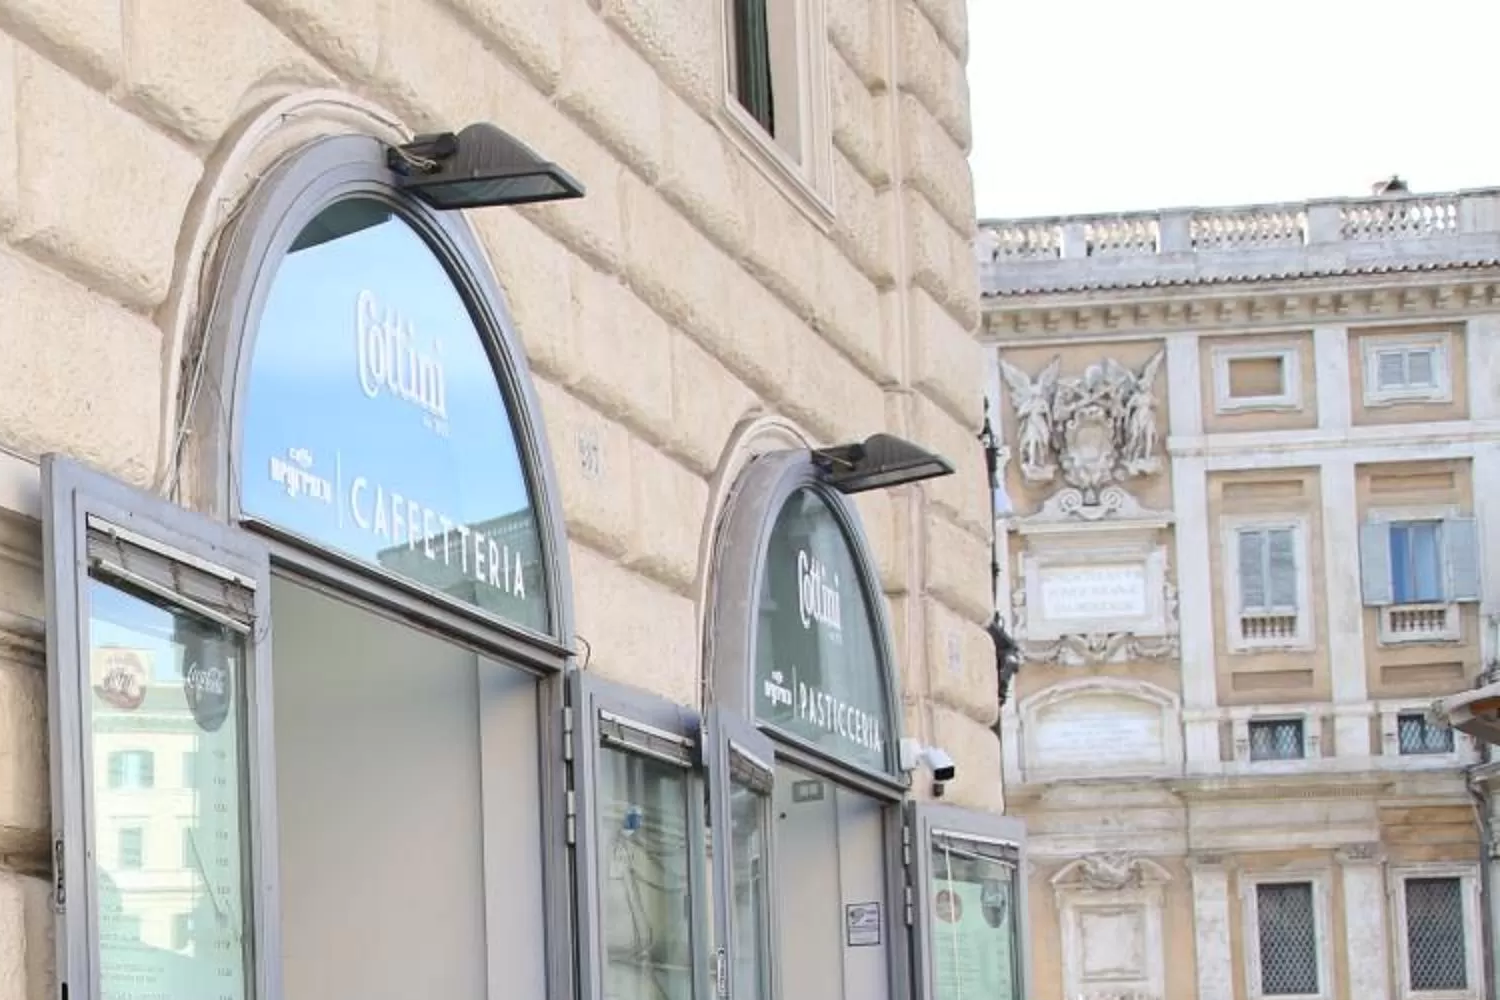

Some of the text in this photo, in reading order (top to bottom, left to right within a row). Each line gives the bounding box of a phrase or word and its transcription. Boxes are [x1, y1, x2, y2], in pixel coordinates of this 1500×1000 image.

[357, 289, 446, 419] Cottini
[351, 475, 526, 600] CAFFETTERIA
[800, 681, 881, 753] PASTICCERIA
